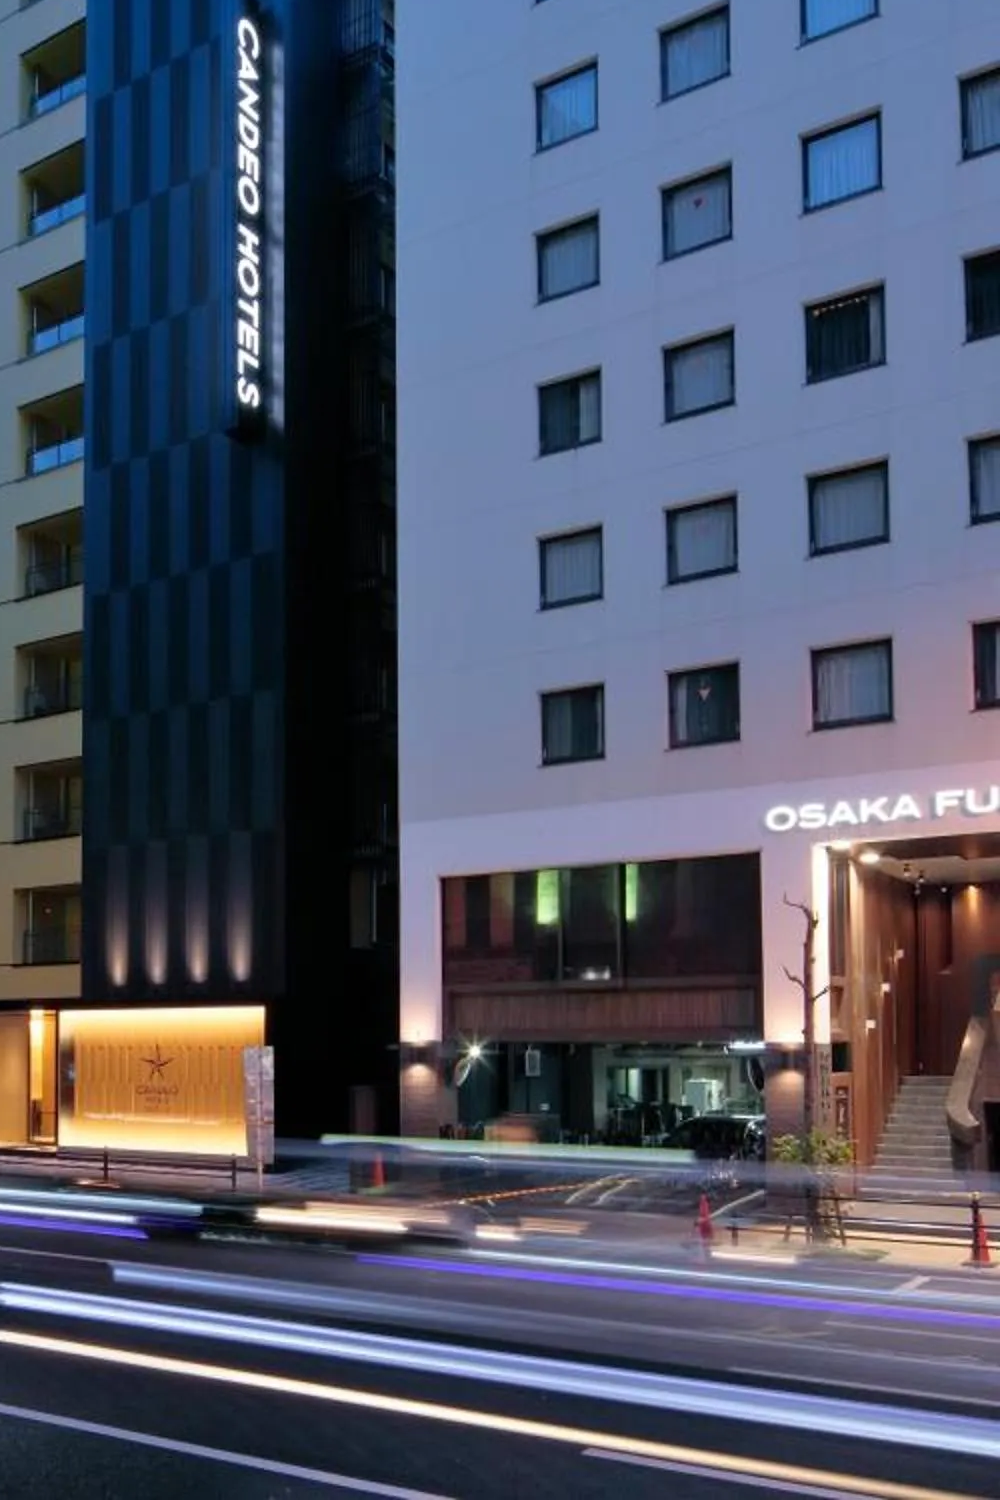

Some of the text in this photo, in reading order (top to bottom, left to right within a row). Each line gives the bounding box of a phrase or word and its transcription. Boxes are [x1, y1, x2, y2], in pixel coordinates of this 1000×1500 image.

[236, 17, 261, 409] CANDEO HOTELS
[763, 785, 1000, 833] OSAKA FU
